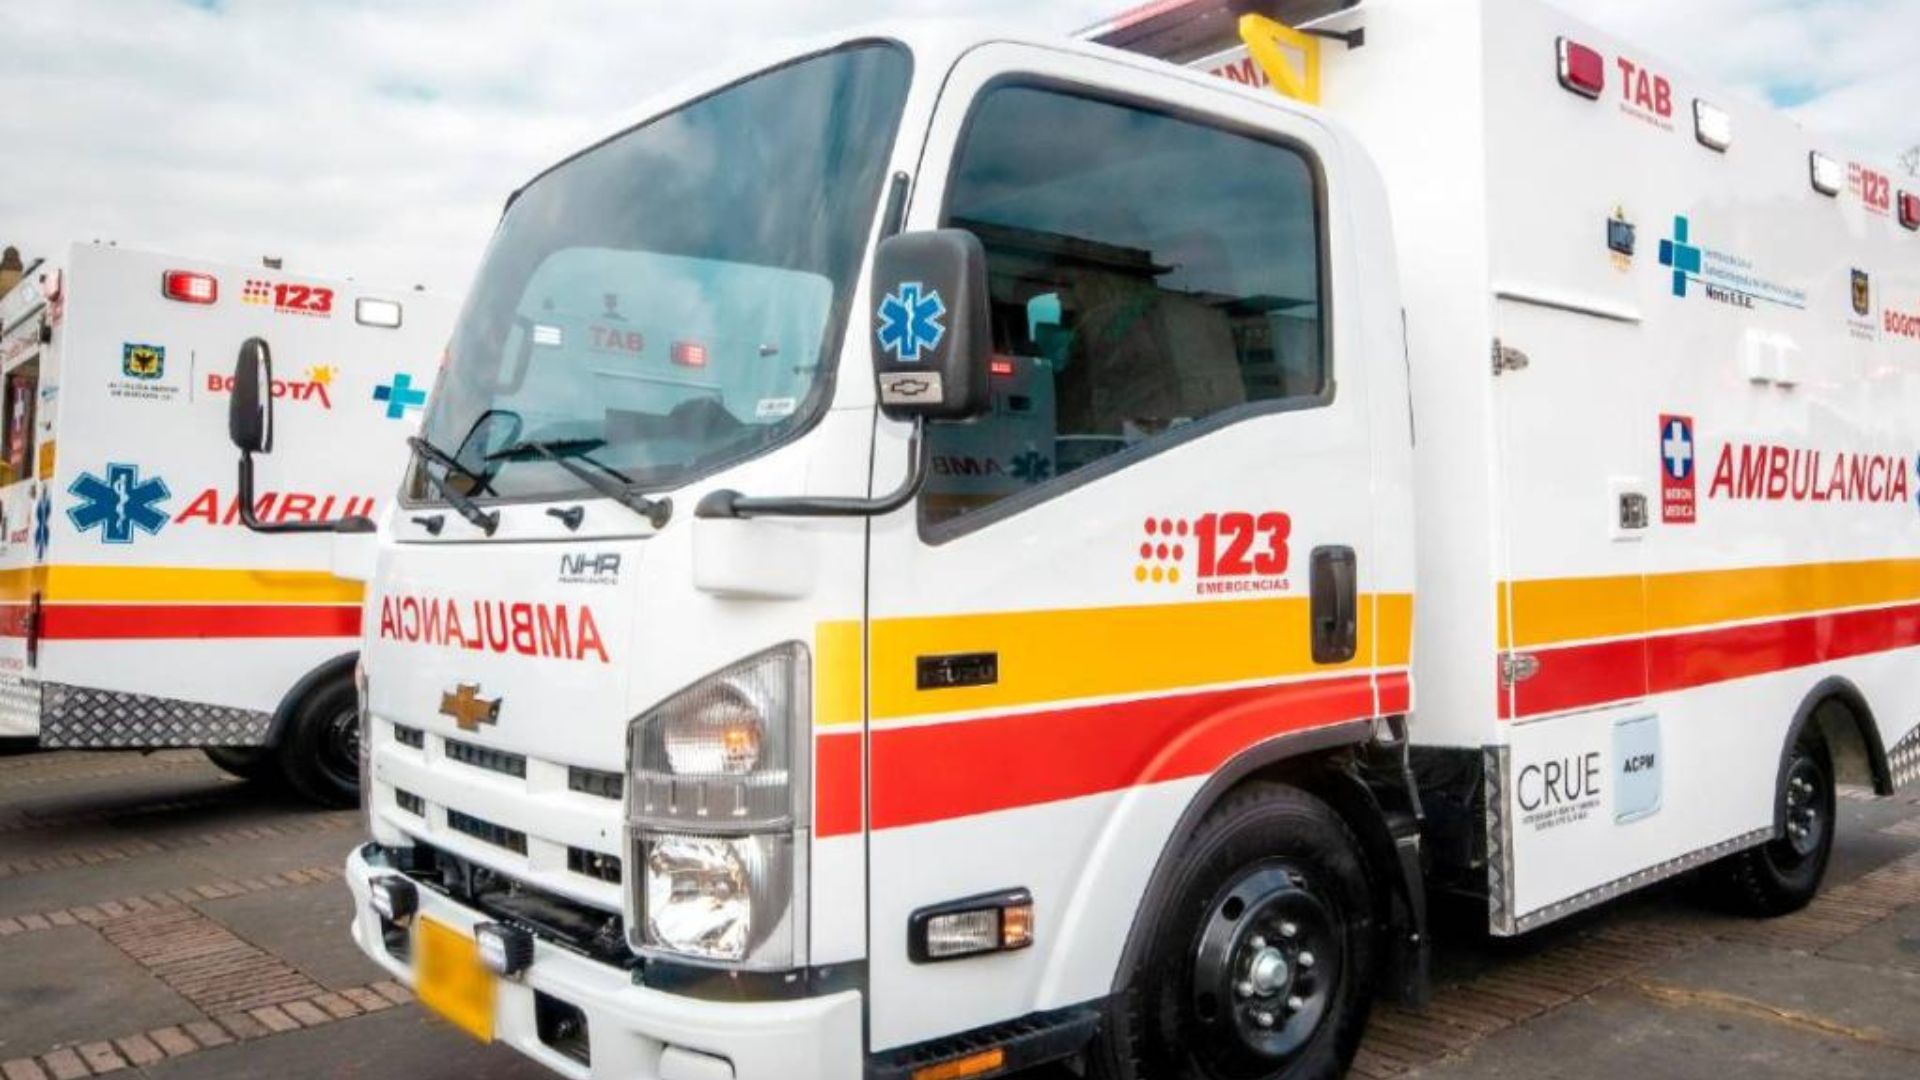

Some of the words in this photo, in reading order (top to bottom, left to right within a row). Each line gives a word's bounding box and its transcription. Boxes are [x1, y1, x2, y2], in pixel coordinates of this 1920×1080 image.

[1617, 56, 1672, 118] TAB
[1861, 169, 1890, 210] 123
[273, 283, 333, 313] 123
[1709, 443, 1909, 503] AMBULANCIA
[560, 553, 621, 575] NHR
[1193, 511, 1292, 577] 123
[1197, 579, 1290, 594] EMERGENCIAS
[1518, 752, 1600, 812] CRUE
[1623, 753, 1655, 774] ACPM
